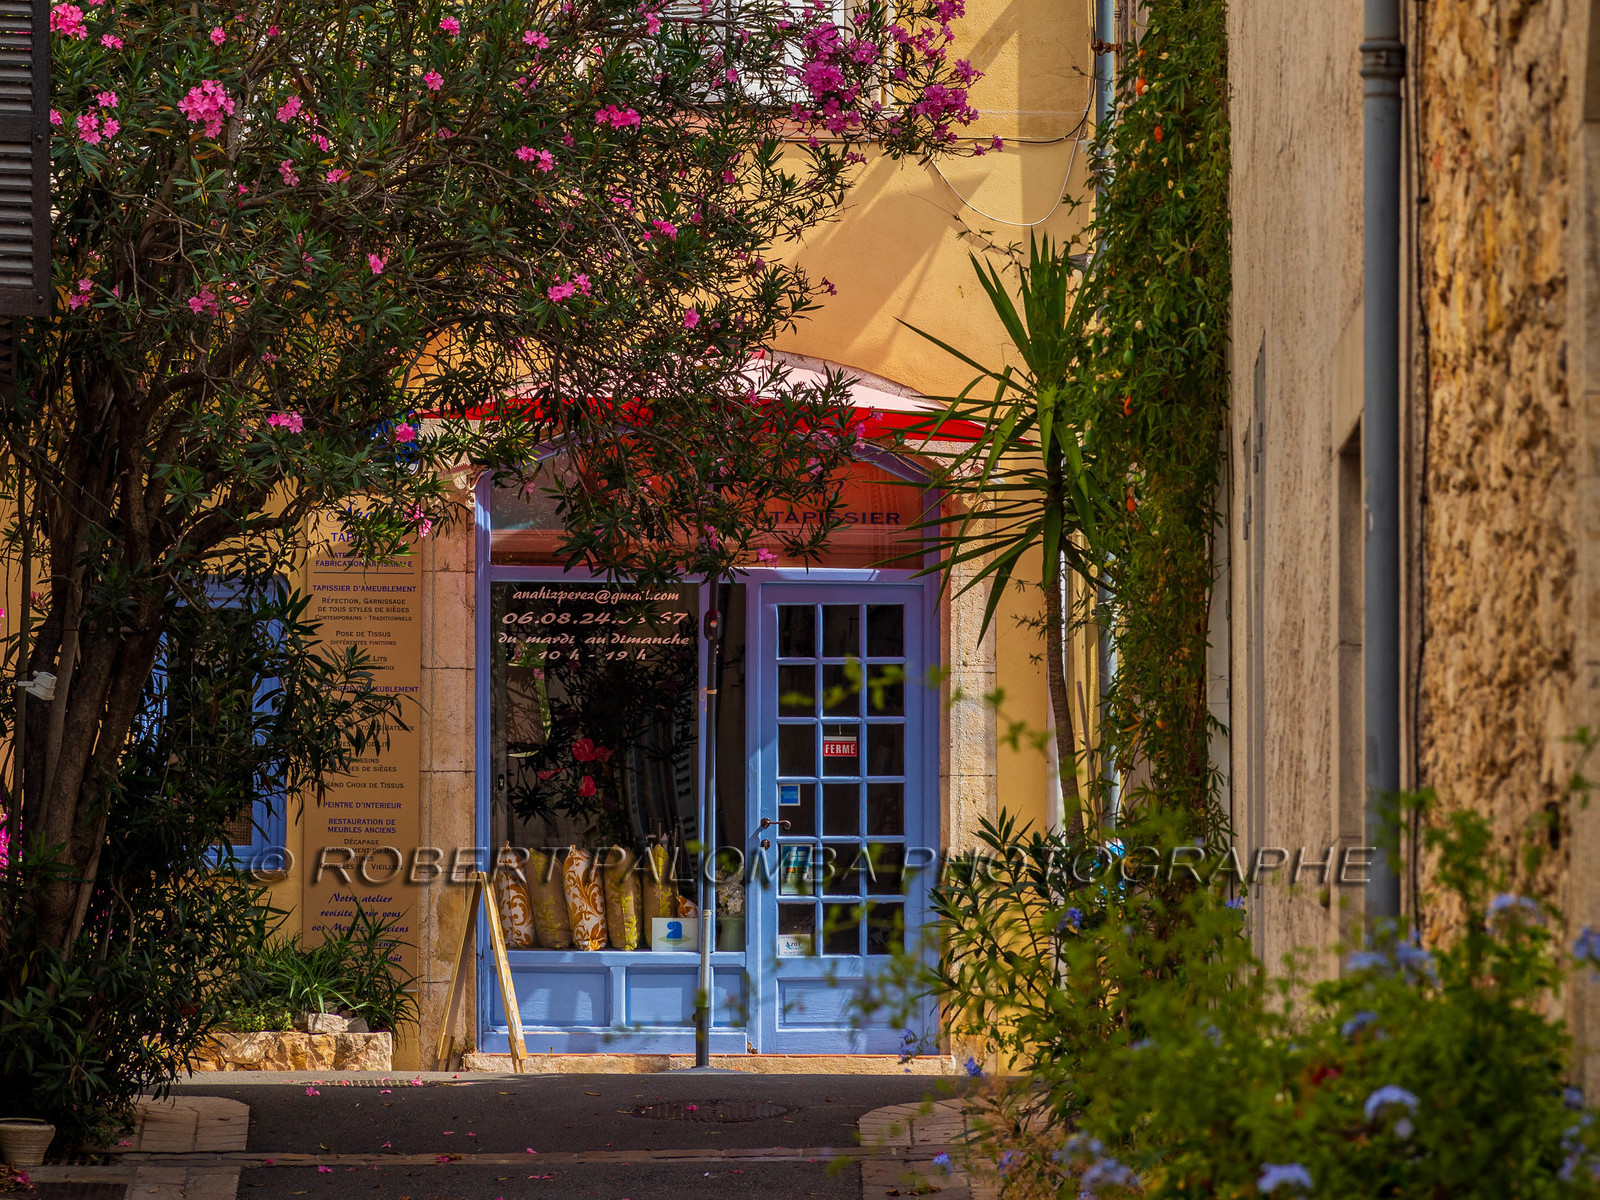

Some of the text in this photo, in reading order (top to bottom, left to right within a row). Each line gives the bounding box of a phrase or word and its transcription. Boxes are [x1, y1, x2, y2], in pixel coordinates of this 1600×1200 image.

[769, 511, 900, 524] TAPISSIER
[363, 597, 406, 605] GARNISSAGE
[385, 605, 410, 613] SIÈGES
[498, 632, 690, 645] du mardi au dimanche
[538, 650, 561, 660] 10
[569, 648, 580, 661] h
[605, 650, 628, 661] 19
[636, 648, 646, 661] h
[380, 781, 404, 789] TISSUS
[343, 837, 380, 845] DÉCAPAGE
[361, 894, 393, 903] atelier
[320, 909, 353, 917] revisite
